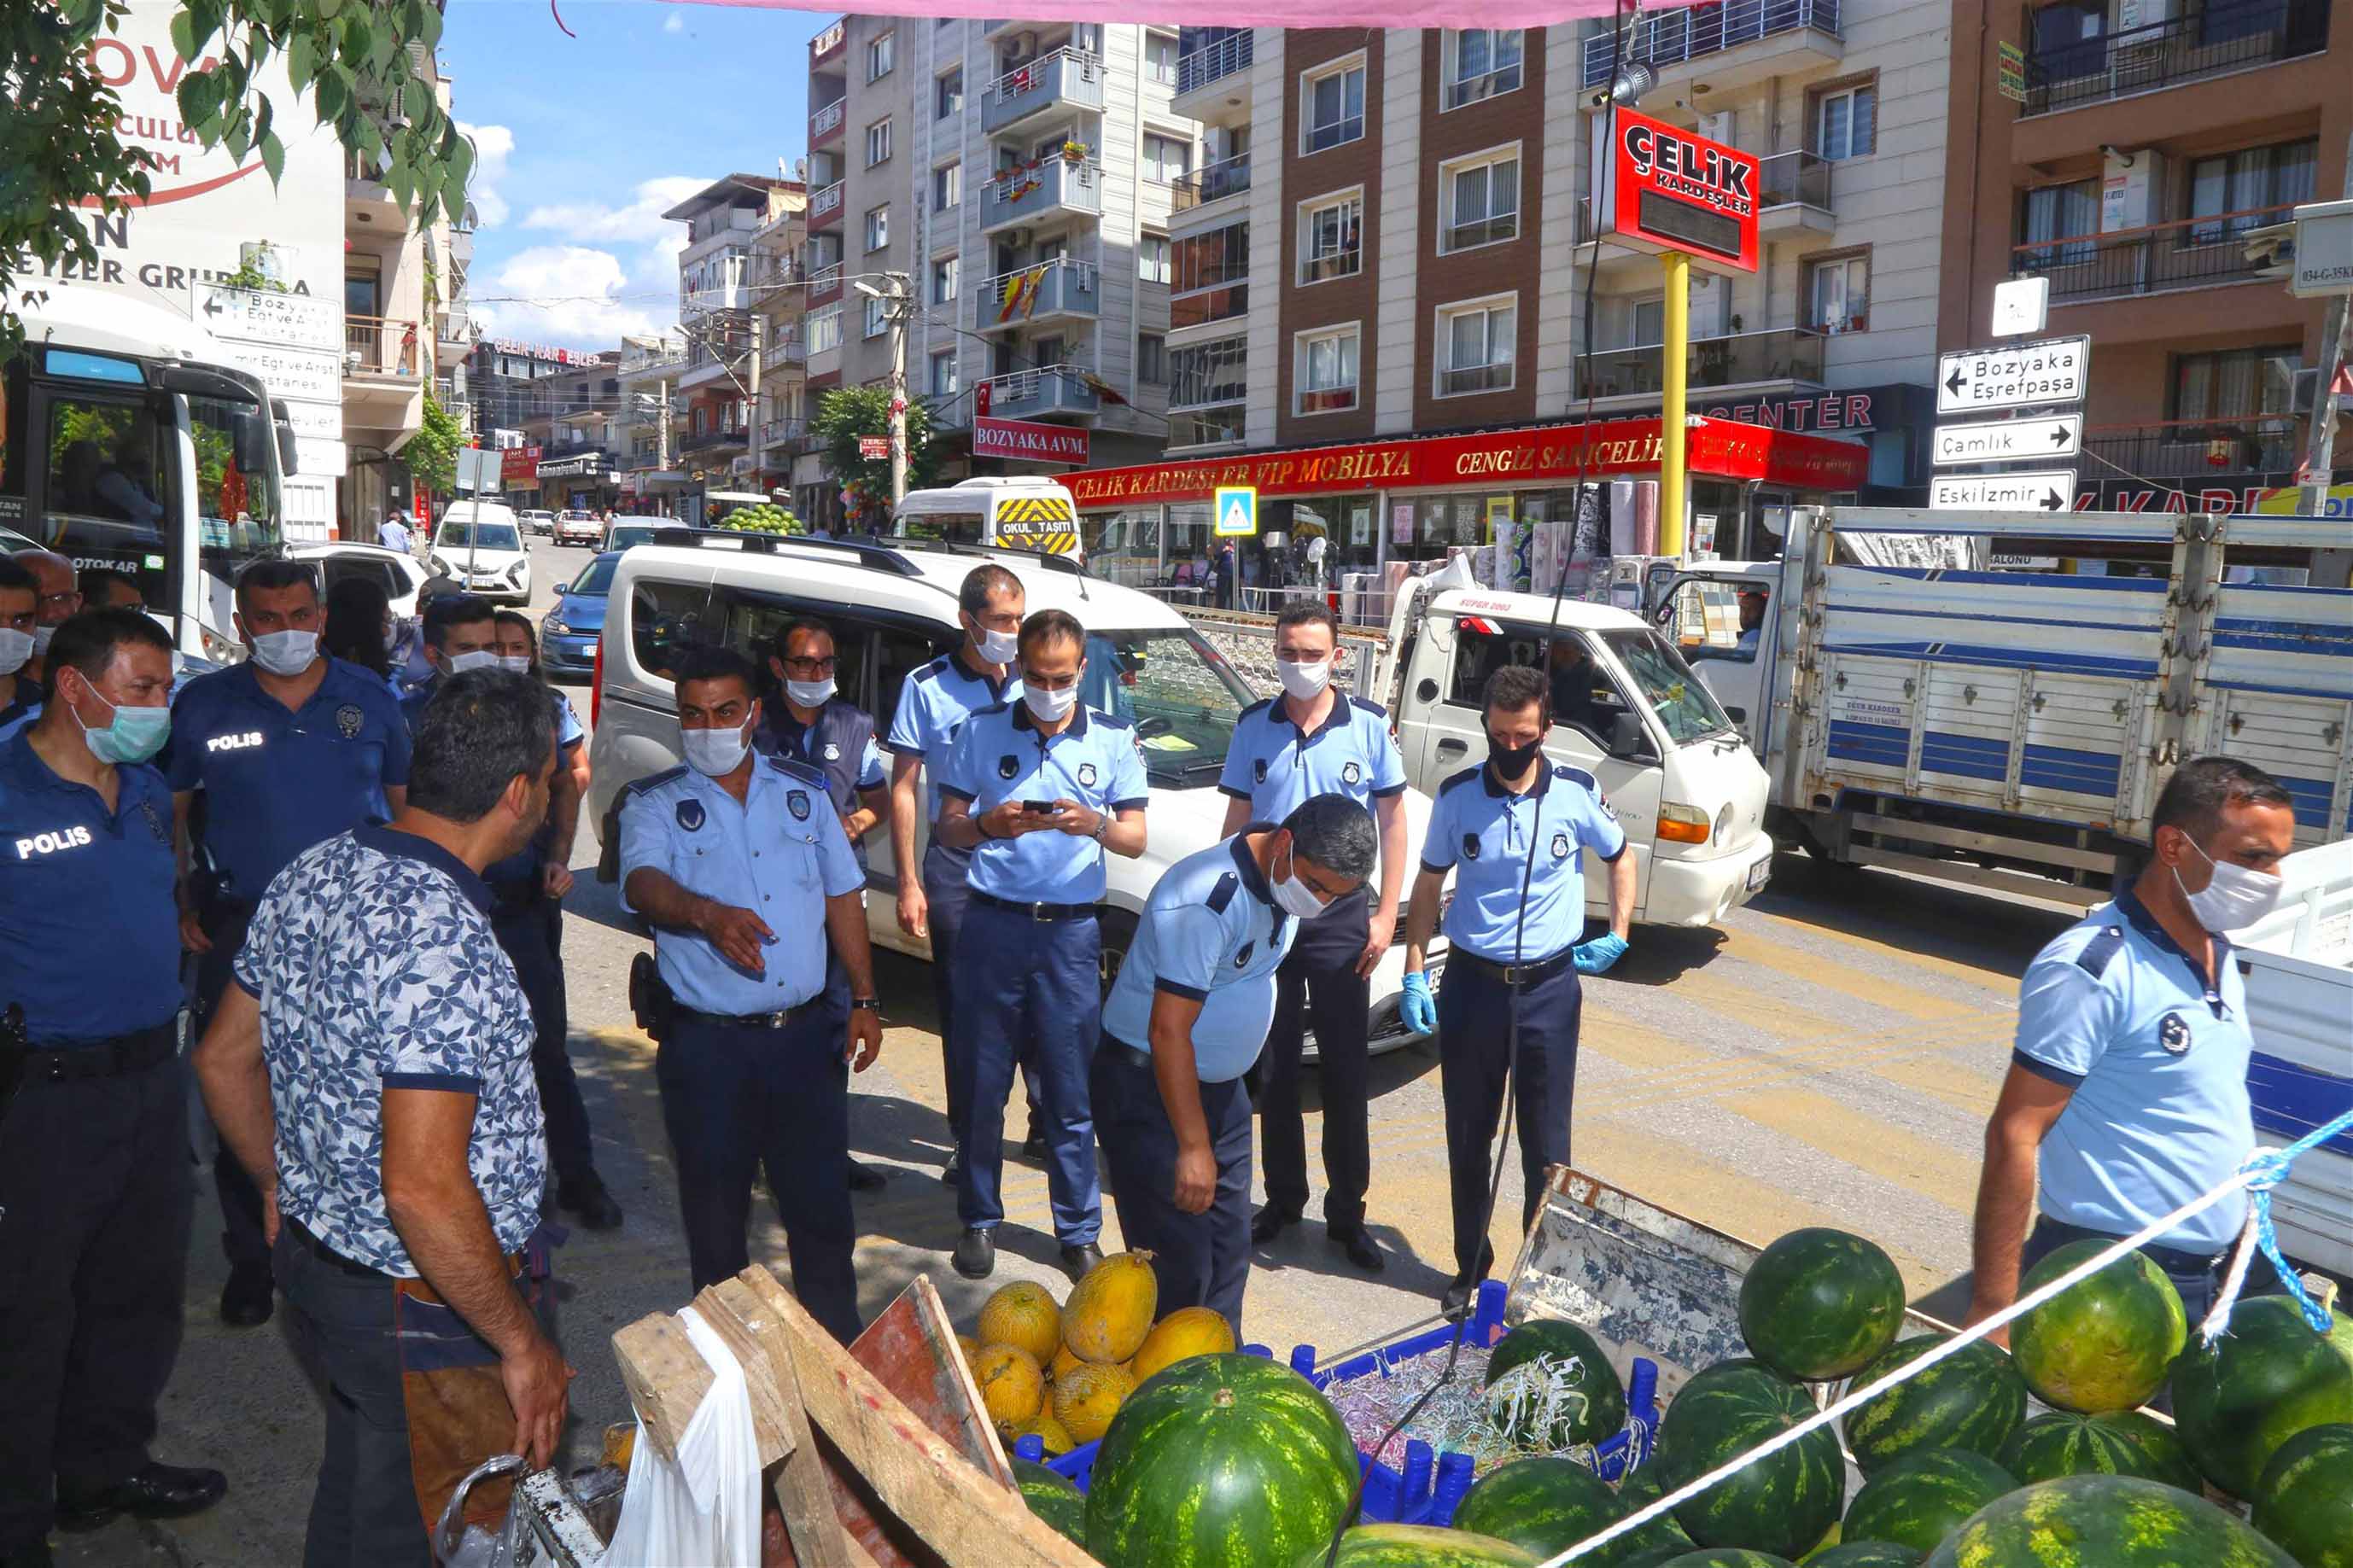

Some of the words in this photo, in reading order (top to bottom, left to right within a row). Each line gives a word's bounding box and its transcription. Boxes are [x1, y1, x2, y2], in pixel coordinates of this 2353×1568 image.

[1656, 173, 1751, 216] KARDEŞLER
[1975, 352, 2074, 377] Bozyaka
[260, 376, 323, 390] astanesi
[1973, 377, 2075, 401] Eşrefpaşa
[977, 428, 1047, 449] BOZYAKA
[1051, 435, 1087, 455] AVM.
[1942, 434, 2012, 455] Çamlık
[1298, 450, 1411, 483] MOBİLYA
[1456, 444, 1535, 475] CENGİZ
[1003, 522, 1031, 533] OKUL
[1039, 521, 1071, 534] TAŞITI
[73, 557, 138, 574] OTOKAR
